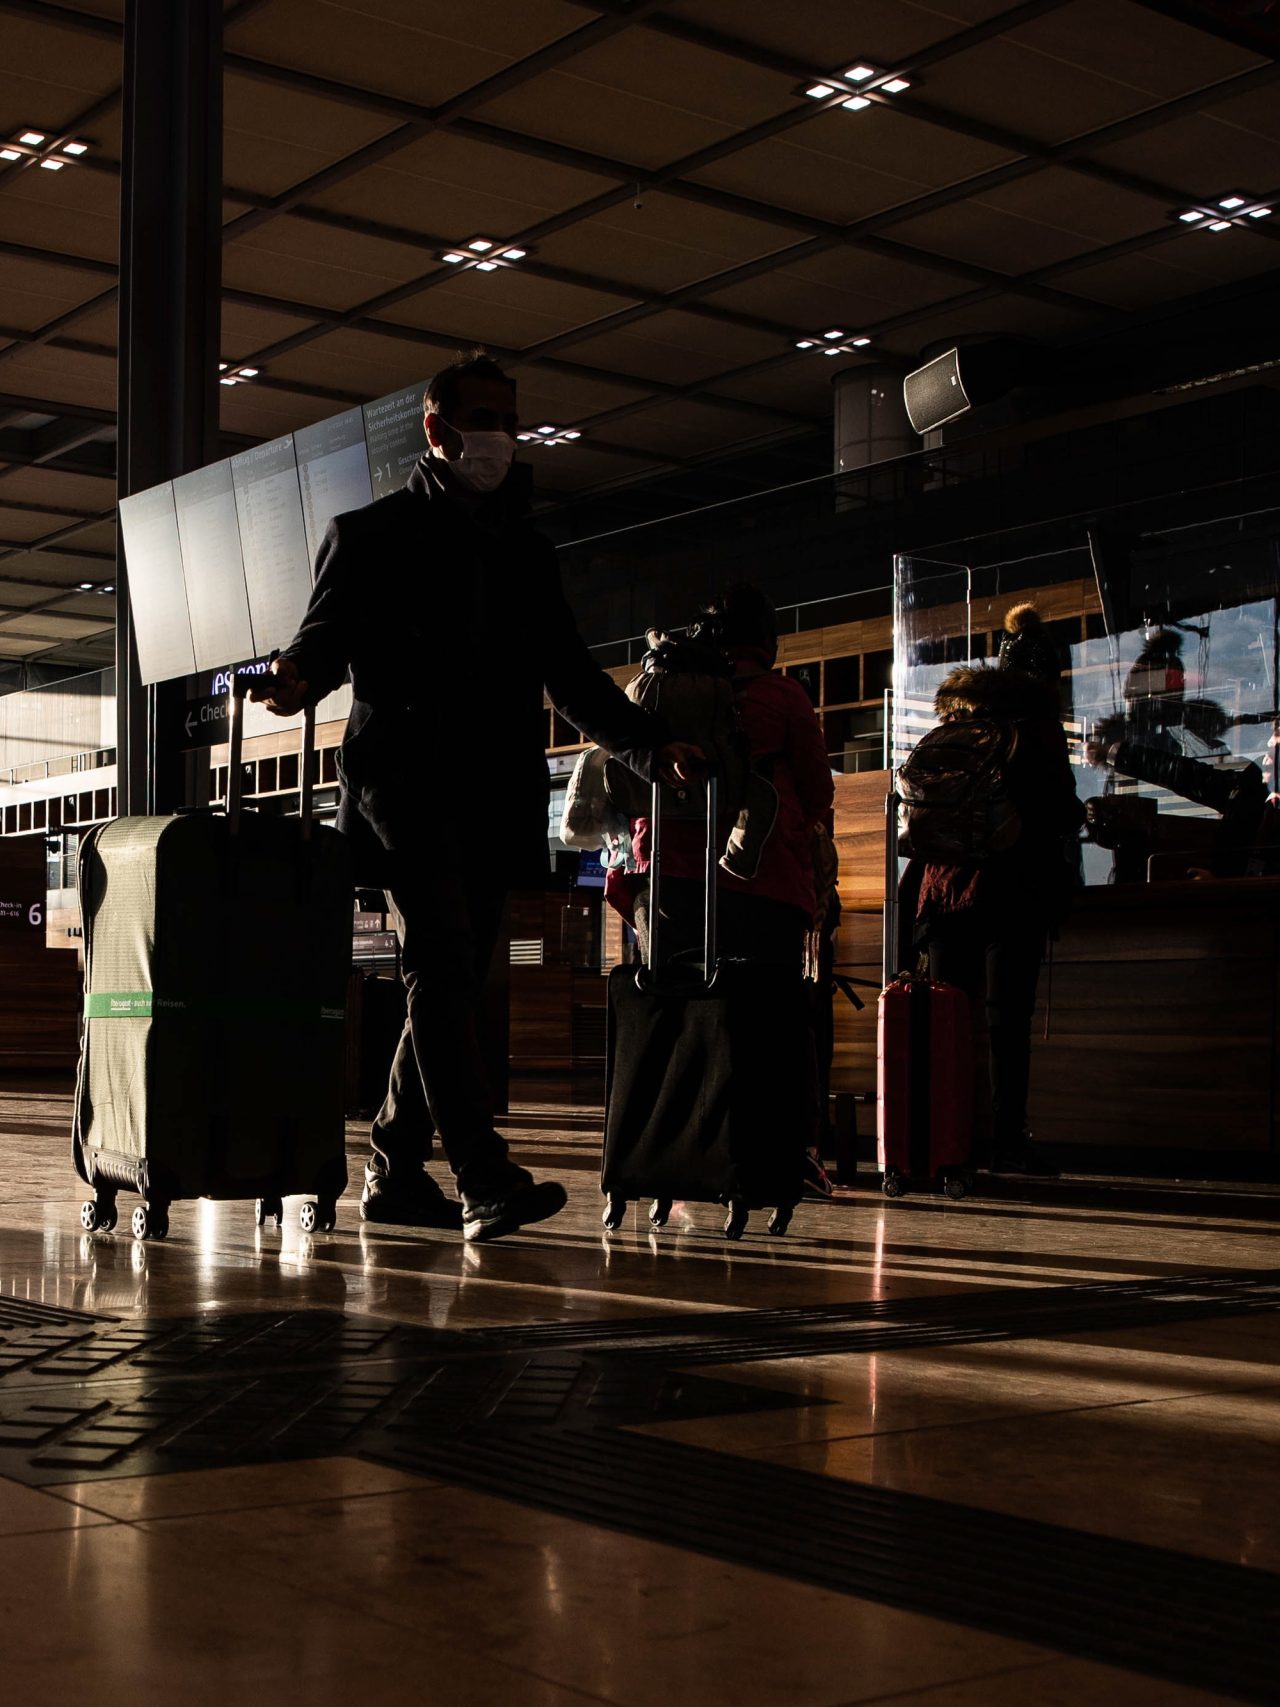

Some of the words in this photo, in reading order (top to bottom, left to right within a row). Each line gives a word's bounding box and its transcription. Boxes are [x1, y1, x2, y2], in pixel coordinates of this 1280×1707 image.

[367, 402, 395, 418] Wartezeit
[396, 398, 404, 407] an
[405, 394, 415, 404] der
[368, 402, 423, 431] Sicherheitskontrol
[200, 700, 228, 722] Chec
[28, 903, 42, 925] 6
